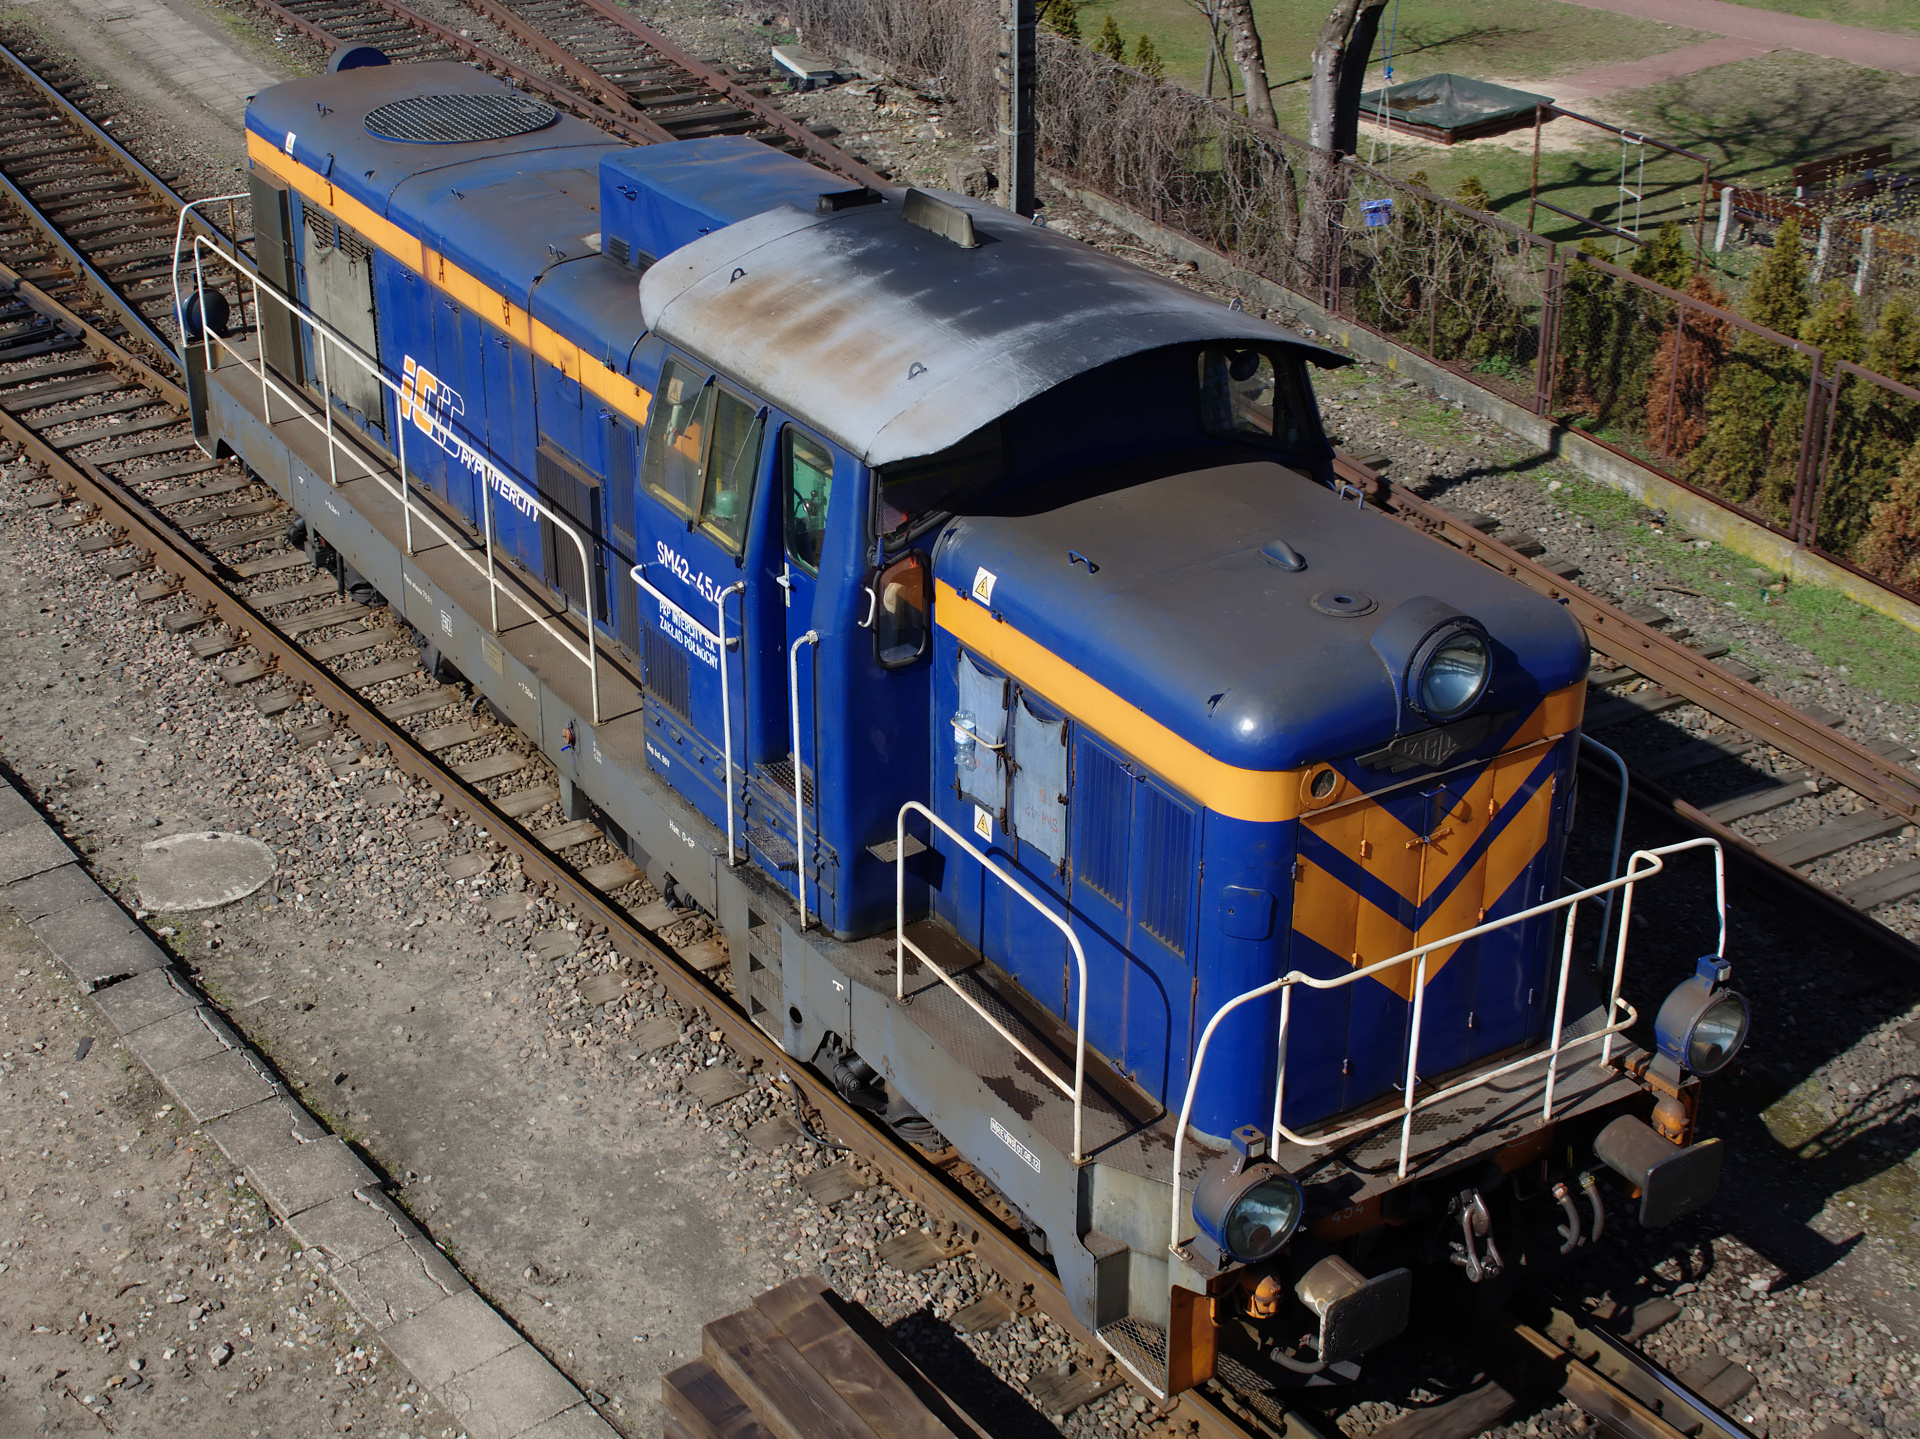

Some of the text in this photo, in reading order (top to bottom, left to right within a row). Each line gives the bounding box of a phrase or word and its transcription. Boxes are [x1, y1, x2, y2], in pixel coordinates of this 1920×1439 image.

[487, 468, 539, 522] NTERCITY
[659, 600, 671, 619] PKP
[659, 615, 718, 671] ZAKŁAD PÓŁNOCNY
